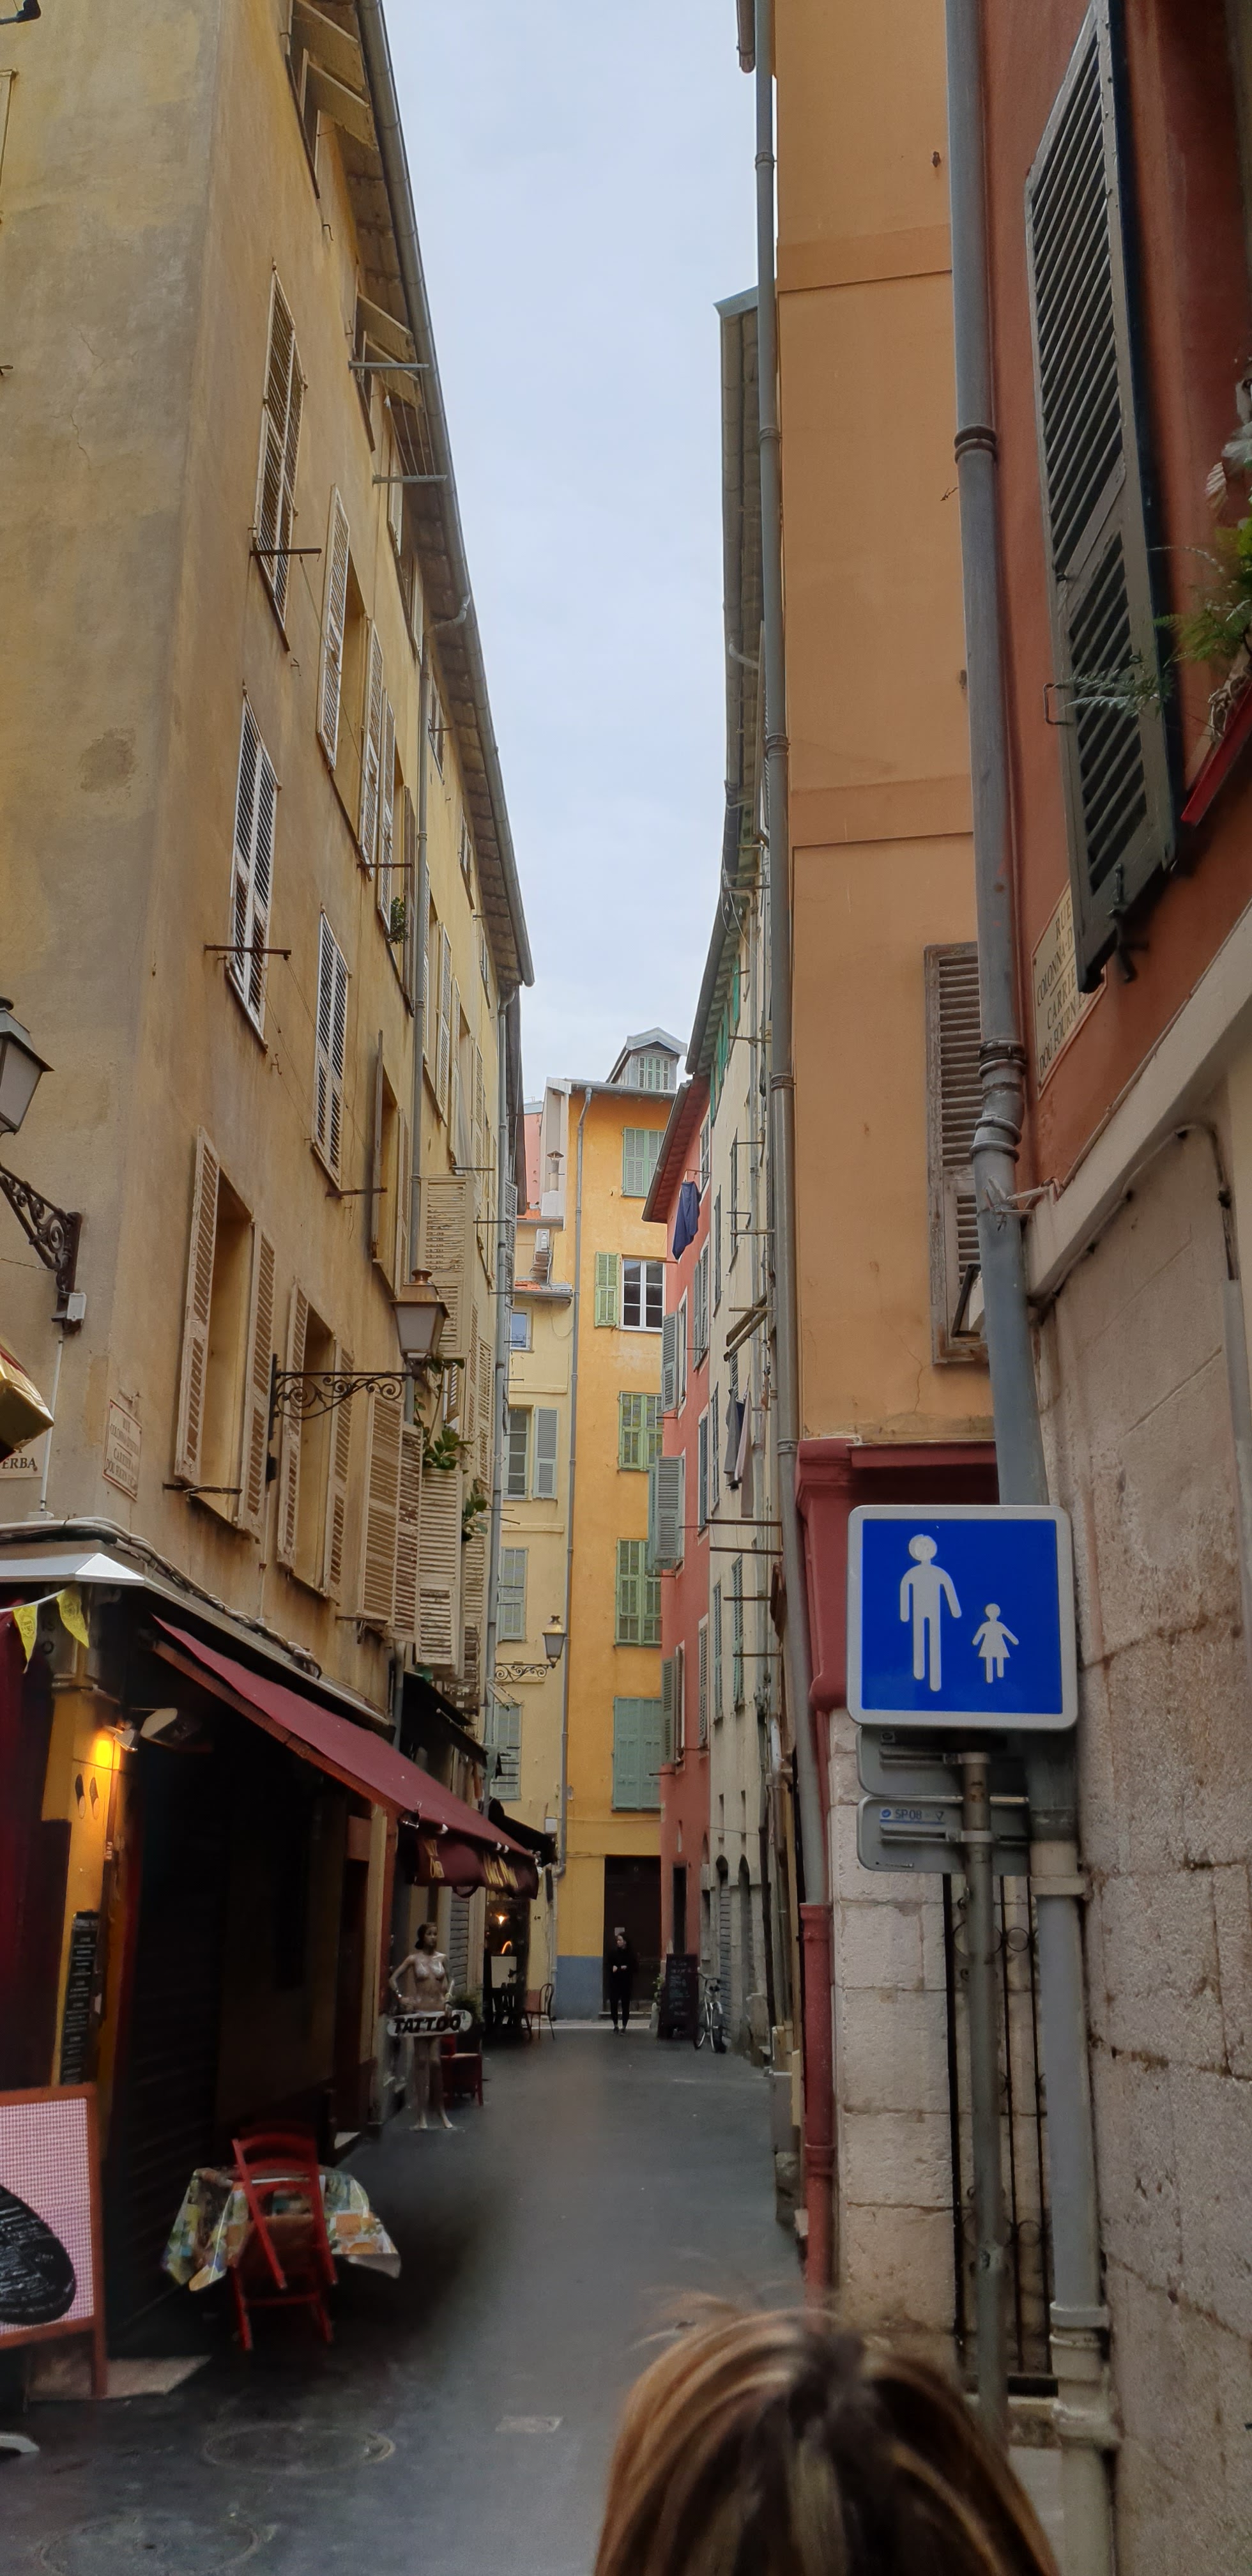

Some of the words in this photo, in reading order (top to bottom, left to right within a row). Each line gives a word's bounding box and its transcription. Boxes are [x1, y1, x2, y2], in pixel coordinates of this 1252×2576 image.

[1055, 896, 1071, 942] RUE
[1047, 964, 1076, 1031] CARRIE
[394, 2014, 461, 2034] TATTOO
